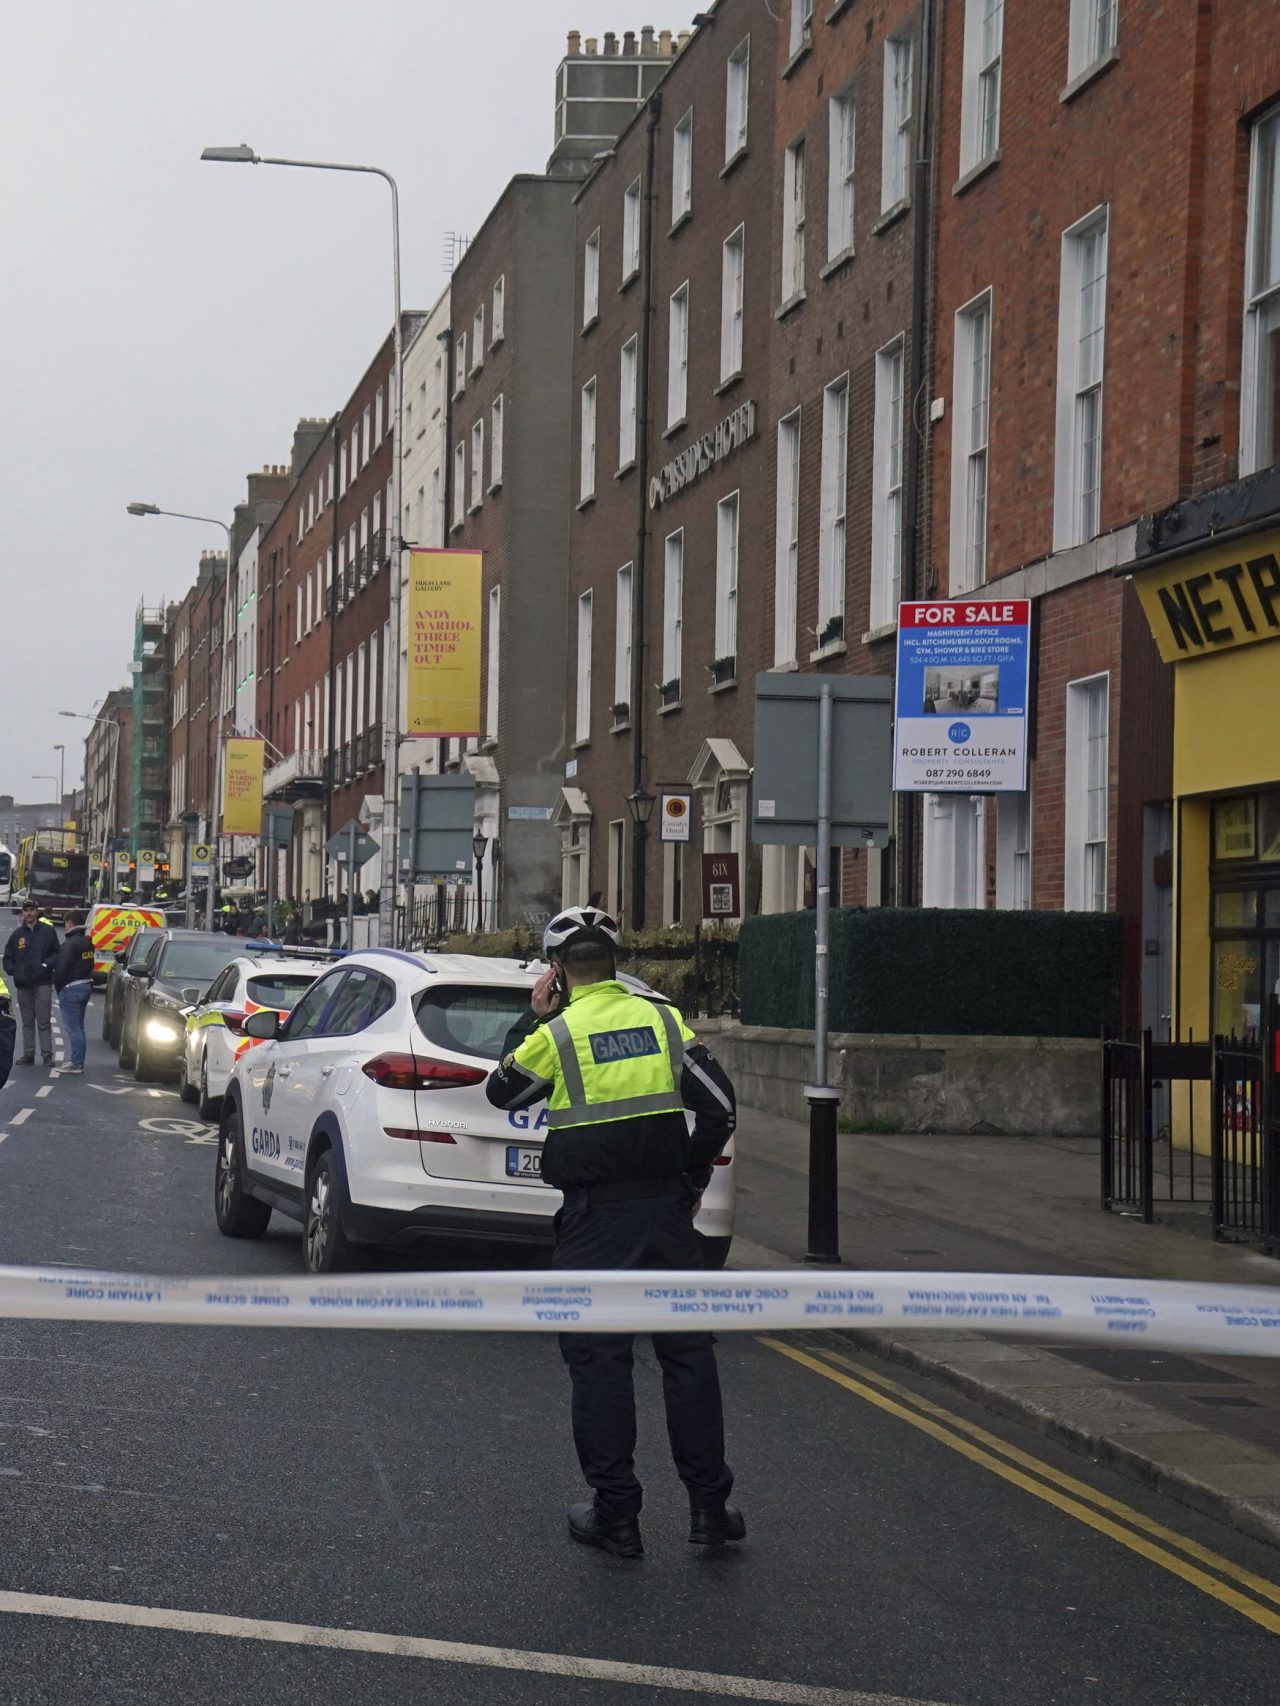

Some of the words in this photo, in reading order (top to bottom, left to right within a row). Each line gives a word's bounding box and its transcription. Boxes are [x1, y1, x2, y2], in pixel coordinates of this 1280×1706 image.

[416, 610, 449, 619] ANDY
[914, 606, 955, 624] FOR
[965, 605, 1014, 623] SALE
[415, 621, 474, 631] WARHOL
[415, 632, 460, 641] THREE
[415, 643, 456, 653] TIMES
[934, 646, 963, 654] SHOWER
[414, 654, 442, 664] OUT
[902, 748, 948, 756] ROBERT
[953, 748, 1016, 756] COLLERAN
[926, 769, 944, 778] 087
[946, 769, 964, 778] 290
[966, 769, 991, 778] 6849
[712, 862, 728, 876] SIX
[111, 918, 148, 929] GARDA
[591, 1029, 658, 1061] GARDA
[428, 1119, 468, 1129] HYUNDAI
[252, 1127, 280, 1160] GARDA
[65, 1287, 105, 1299] COIRE
[644, 1288, 698, 1299] ISTEACH
[701, 1288, 732, 1299] DHUL
[734, 1288, 753, 1299] AR
[754, 1288, 789, 1299] COSC
[816, 1289, 855, 1300] ENTRY
[857, 1289, 875, 1300] NO
[206, 1293, 247, 1305] SCENE
[251, 1295, 290, 1306] CRIME
[440, 1298, 483, 1309] UIMHIR
[523, 1296, 592, 1308] Confidential
[671, 1302, 709, 1313] COIRE
[805, 1303, 844, 1314] SCENE
[847, 1303, 884, 1314] CRIME
[536, 1310, 580, 1322] GARDA
